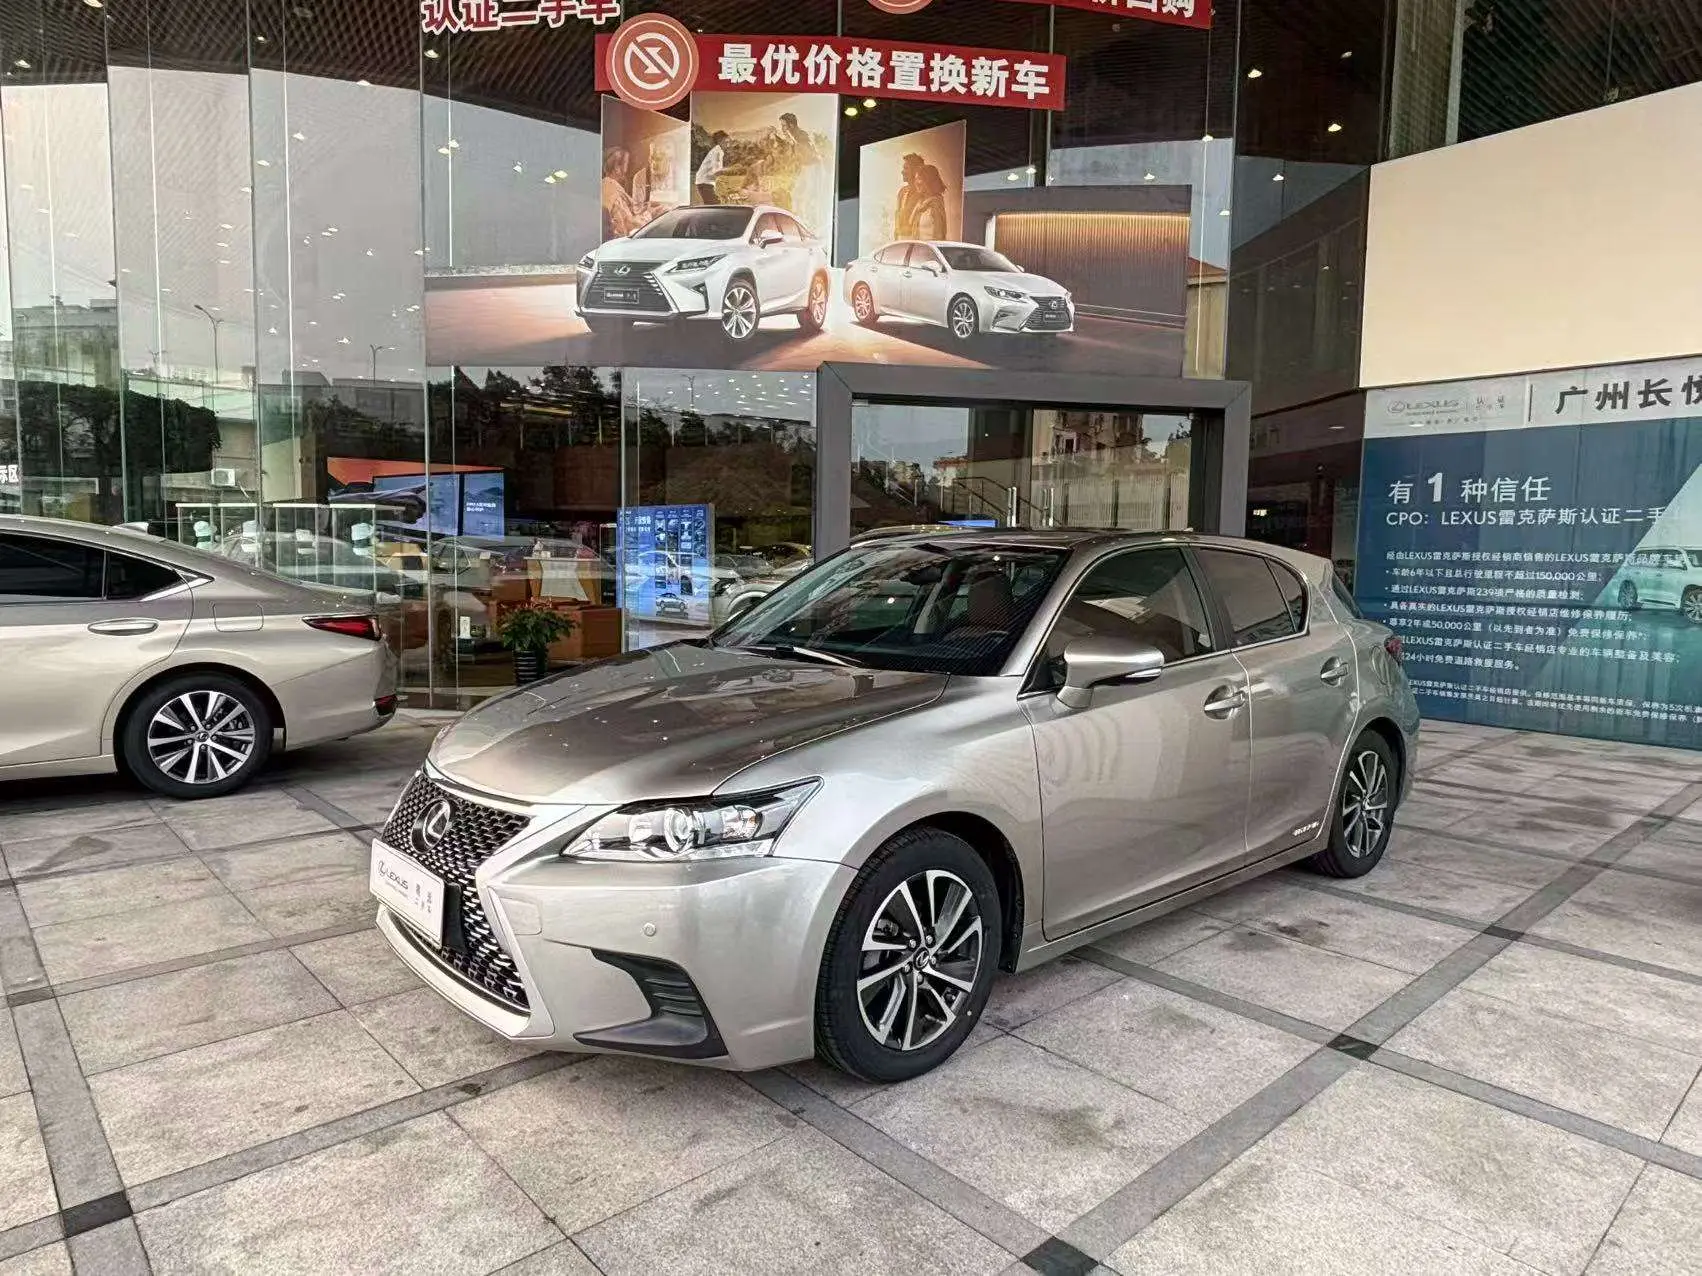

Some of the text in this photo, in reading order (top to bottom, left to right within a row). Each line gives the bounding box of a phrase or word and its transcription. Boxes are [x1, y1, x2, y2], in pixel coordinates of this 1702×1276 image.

[717, 42, 1051, 101] 最优价格置换新车
[1388, 472, 1551, 505] 有 1 种信任
